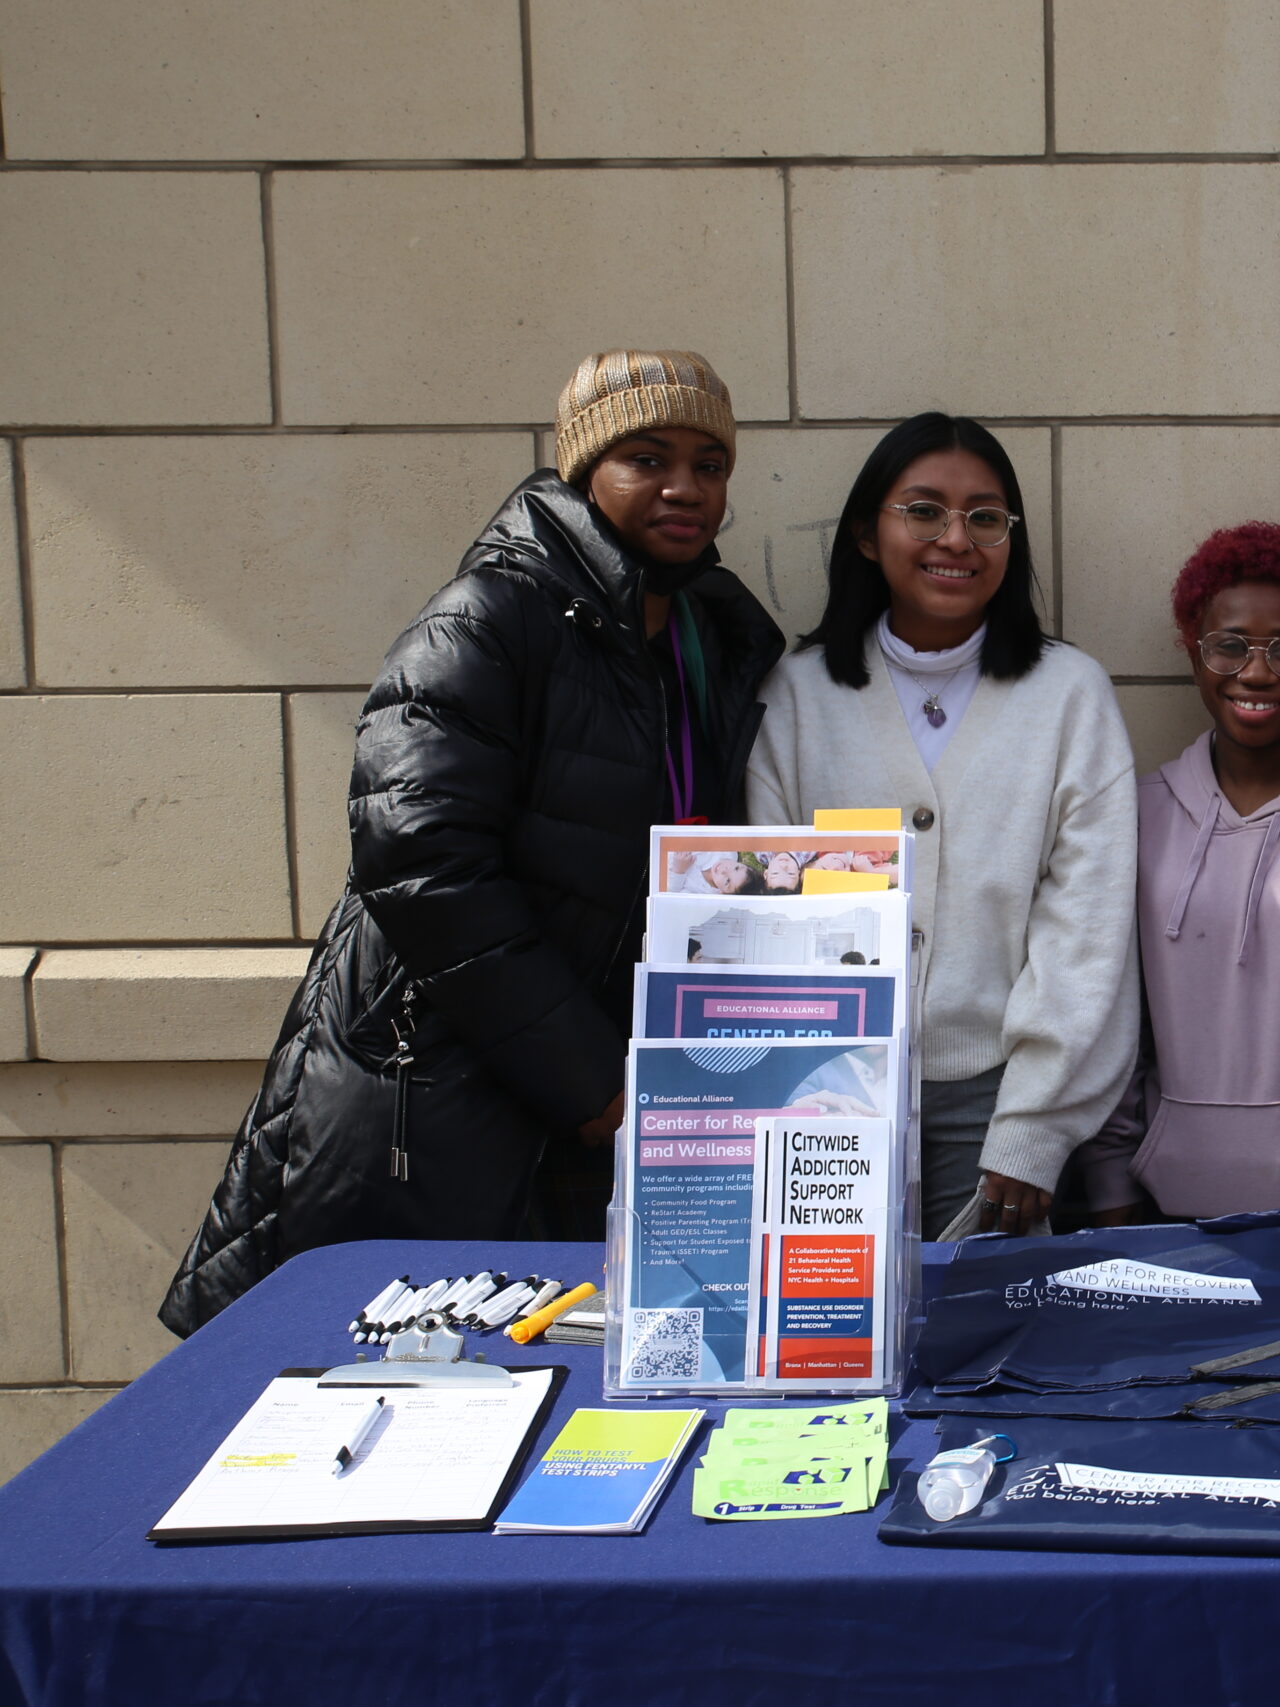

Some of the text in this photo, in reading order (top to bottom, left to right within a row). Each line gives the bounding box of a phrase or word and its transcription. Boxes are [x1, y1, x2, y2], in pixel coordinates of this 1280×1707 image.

[717, 1005, 780, 1013] EDUCATIONAL
[653, 1095, 700, 1103] Educational
[644, 1116, 700, 1130] Center
[704, 1115, 728, 1129] for
[792, 1132, 859, 1151] CITYWIDE
[643, 1143, 752, 1157] and Wellness
[791, 1156, 870, 1175] ADDICTION
[642, 1185, 684, 1194] community
[687, 1185, 723, 1193] programs
[790, 1180, 854, 1200] SUPPORT
[790, 1205, 863, 1225] NETWORK
[1062, 1271, 1190, 1296] AND WELLNESS
[1124, 1266, 1248, 1290] FOR RECOVERY
[734, 1283, 749, 1291] OUT
[1005, 1285, 1262, 1306] EDUCATIONAL ALLIANCE
[1092, 1301, 1130, 1310] here.
[1076, 1469, 1156, 1483] CENTER
[1005, 1491, 1160, 1505] You belong here.
[1007, 1483, 1190, 1499] EDUCATIONAL
[719, 1504, 729, 1515] 1
